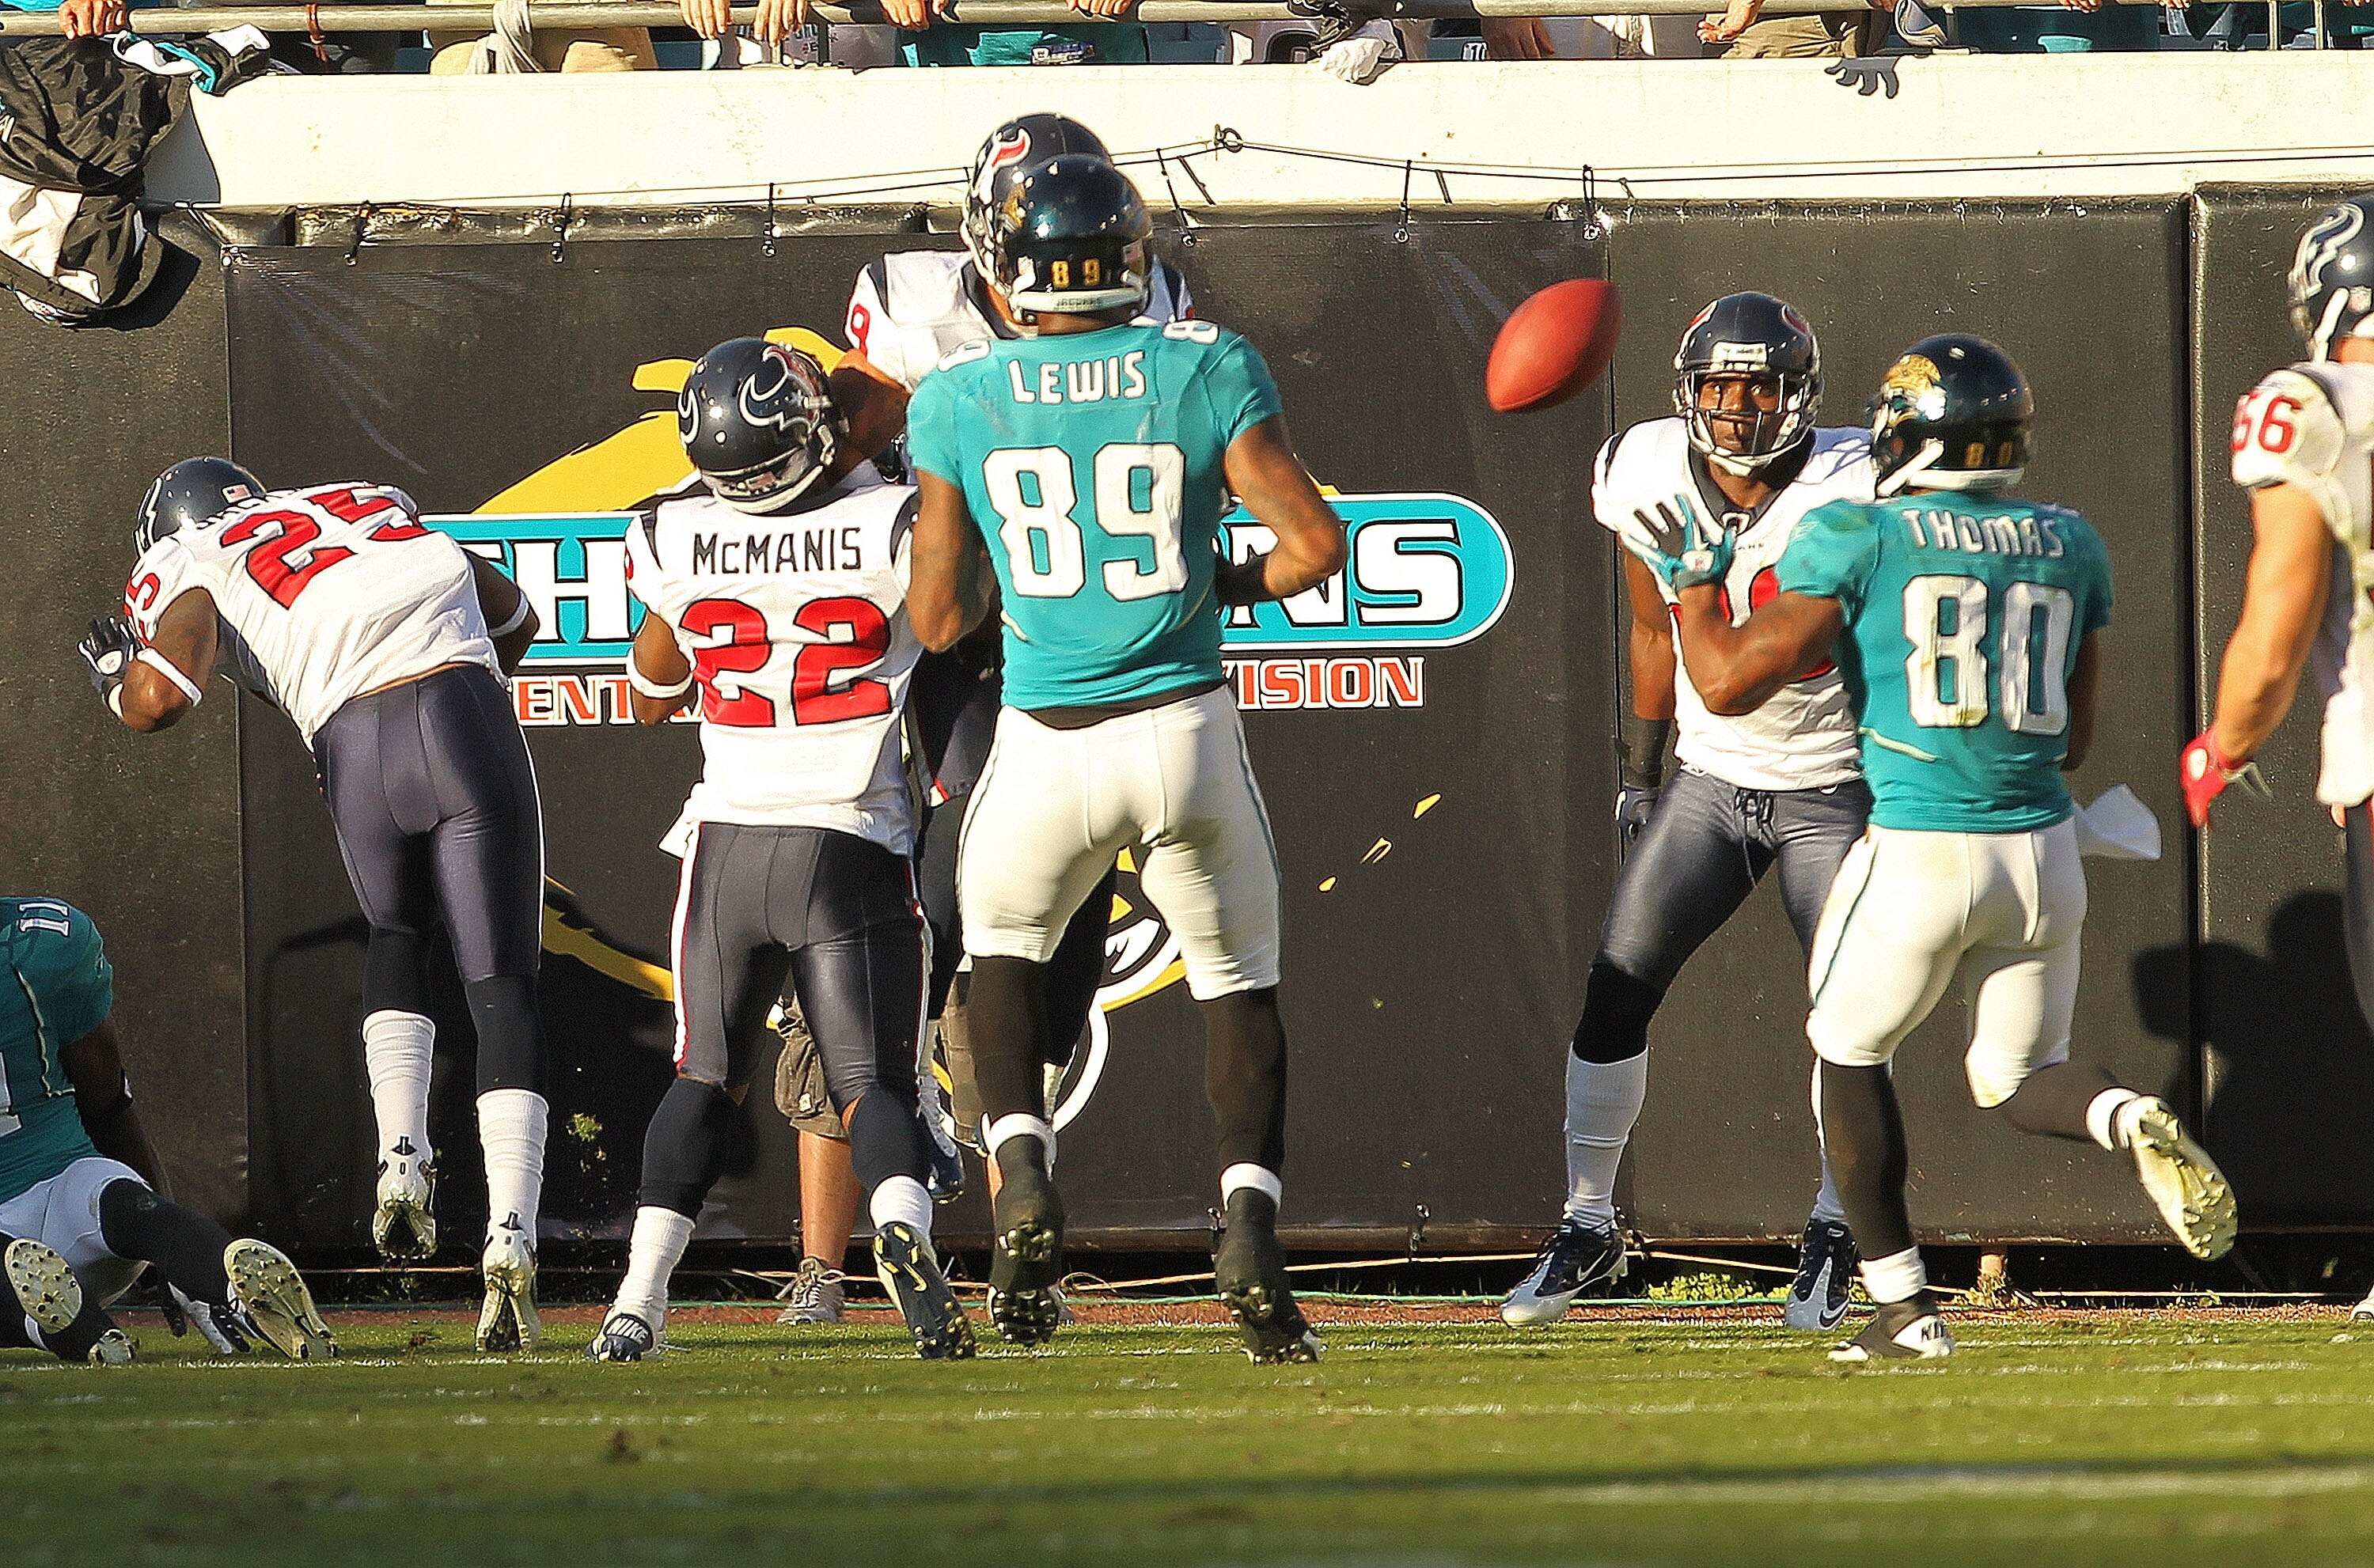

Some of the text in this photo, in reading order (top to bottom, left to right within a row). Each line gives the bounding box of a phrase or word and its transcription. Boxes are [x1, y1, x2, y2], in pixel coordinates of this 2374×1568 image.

[1051, 257, 1101, 288] 89
[1008, 350, 1147, 405] LEWIS
[2232, 390, 2304, 454] 56
[221, 486, 430, 610] 25
[983, 444, 1187, 601] 89
[1902, 509, 2064, 558] THOMAS
[681, 597, 893, 727] 22
[1902, 575, 2074, 736] 80
